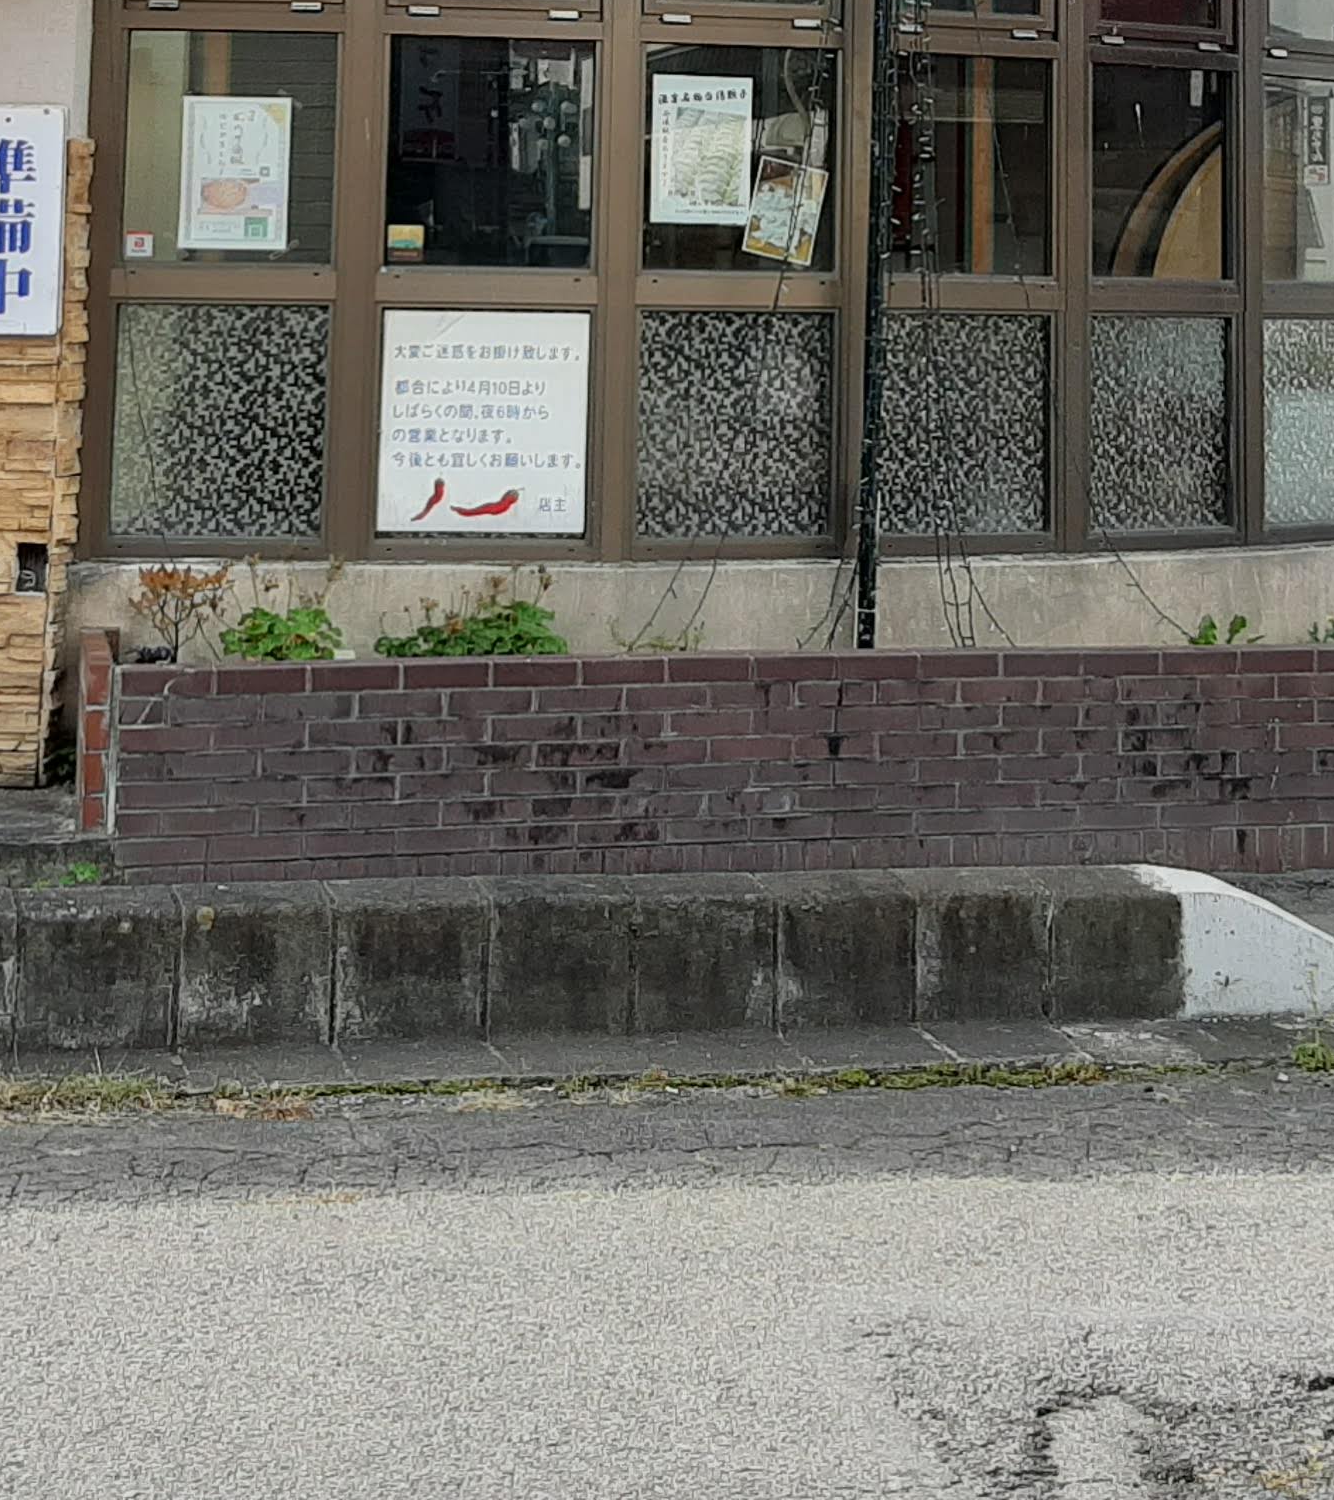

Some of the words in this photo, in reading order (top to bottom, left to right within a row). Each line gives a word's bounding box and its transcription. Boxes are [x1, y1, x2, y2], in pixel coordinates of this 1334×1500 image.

[395, 379, 547, 396] 都合により4月10日より
[391, 428, 513, 444] の営業となります。
[392, 451, 581, 469] 今後とも宜しくお願いします。
[538, 497, 567, 513] 店主
